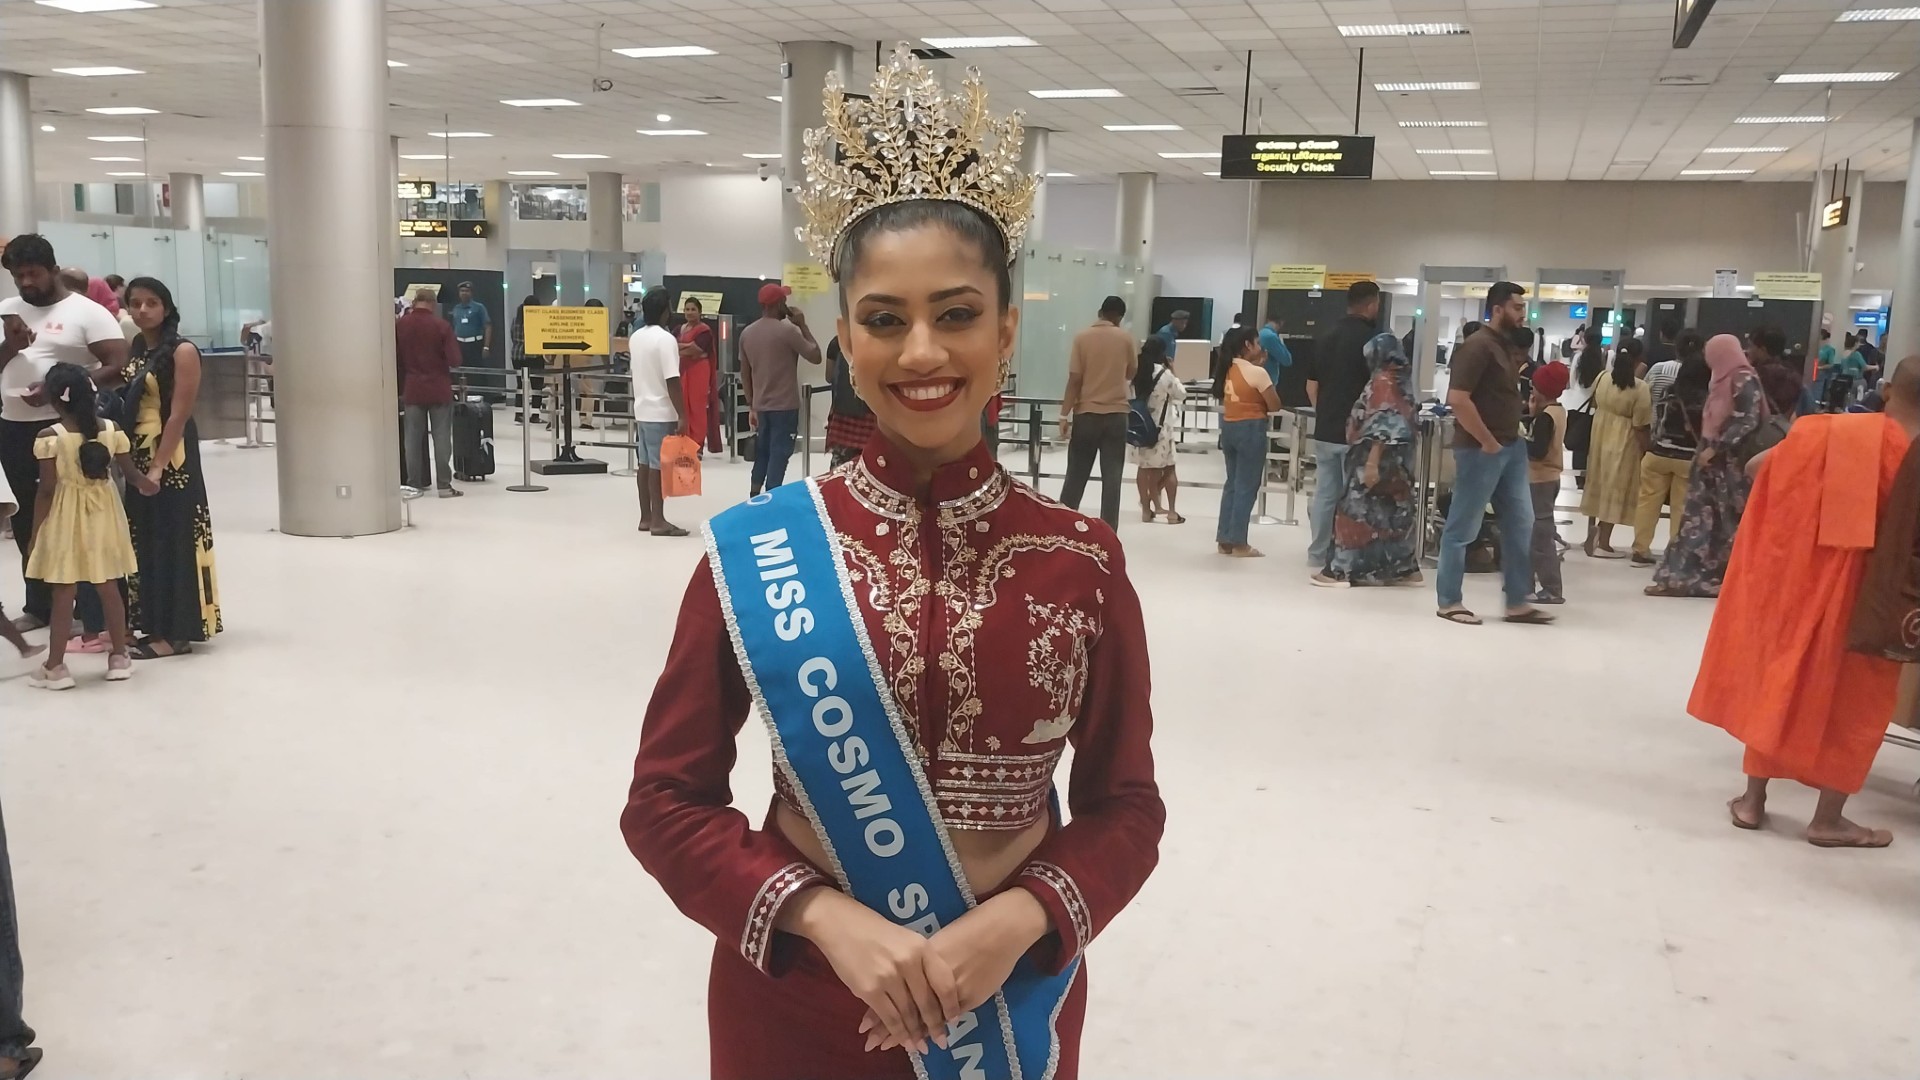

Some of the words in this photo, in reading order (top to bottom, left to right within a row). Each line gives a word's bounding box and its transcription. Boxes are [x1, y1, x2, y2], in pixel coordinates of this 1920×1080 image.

[1257, 162, 1300, 174] Security
[1301, 162, 1335, 172] Check
[750, 528, 815, 641] MISS
[797, 656, 905, 858] COSMO
